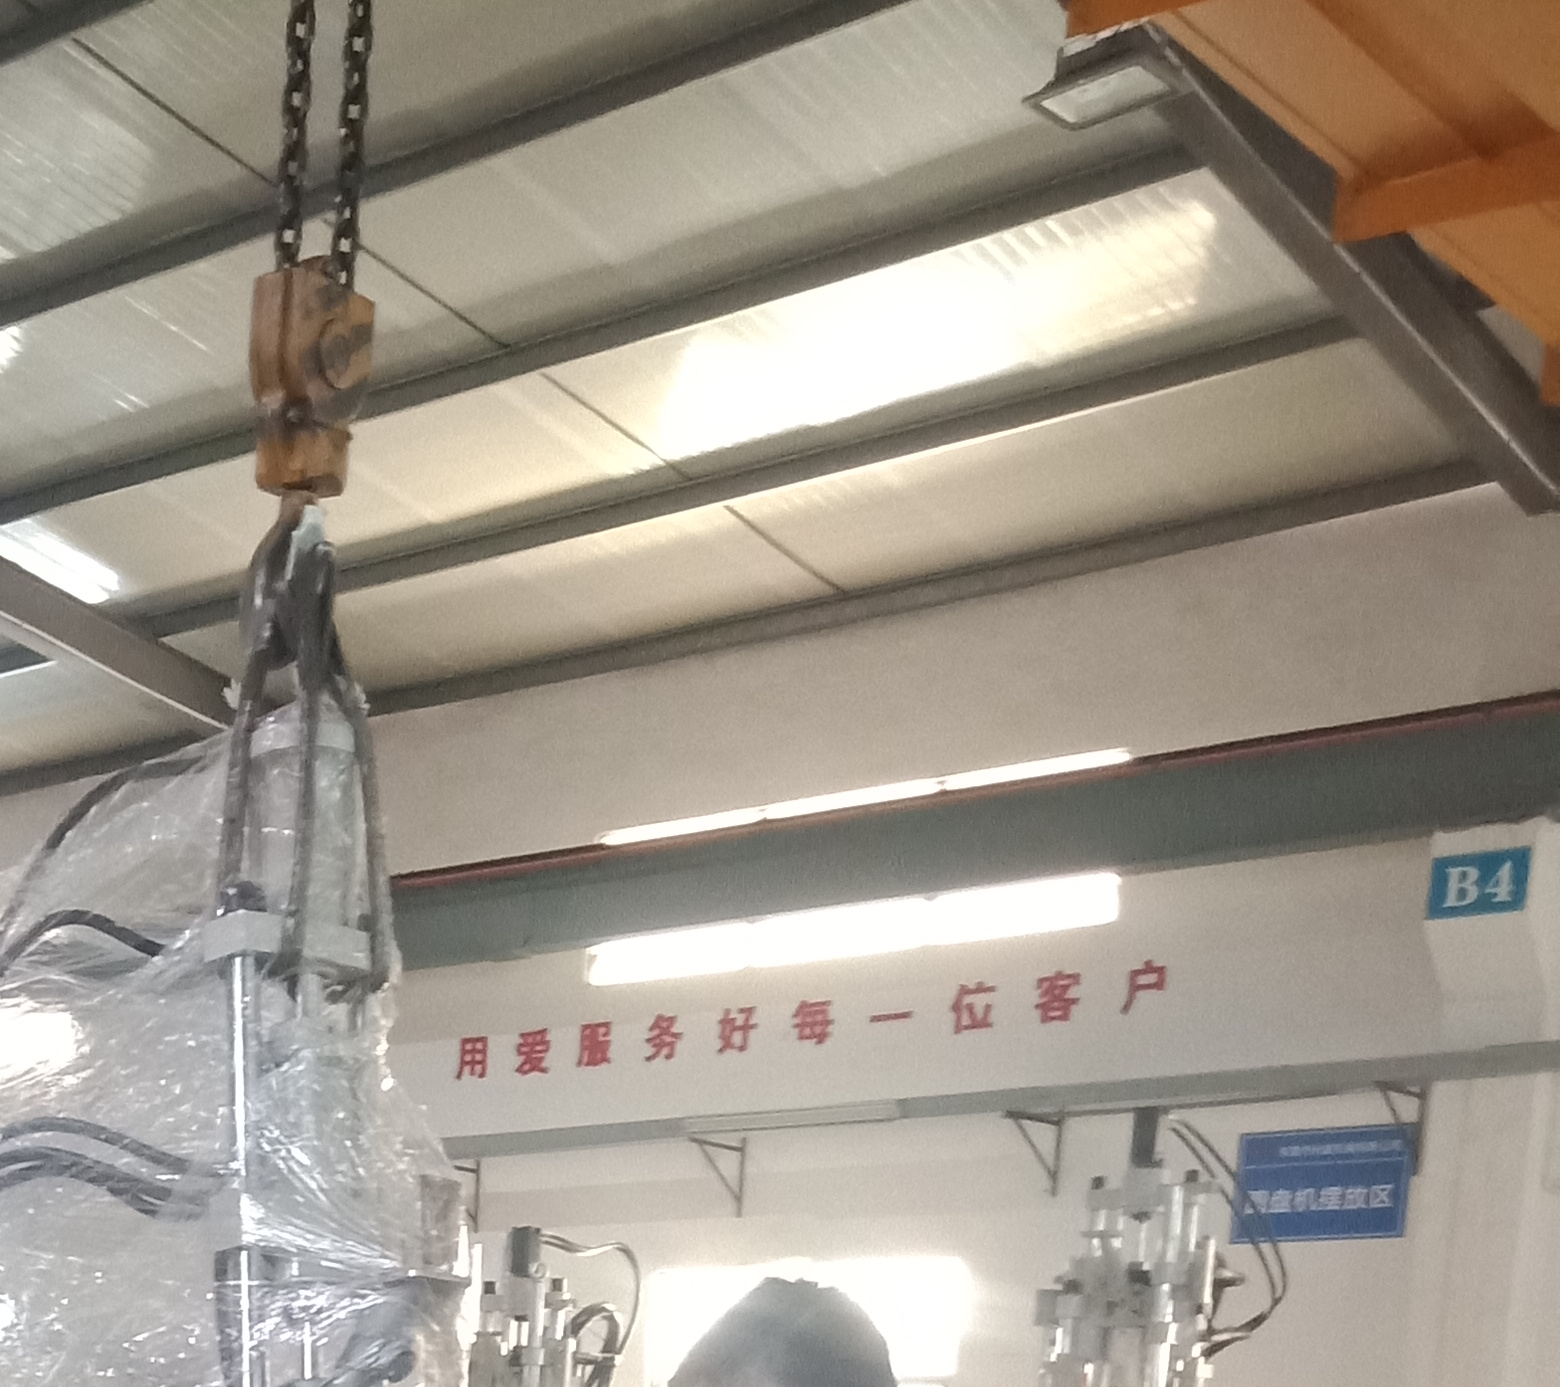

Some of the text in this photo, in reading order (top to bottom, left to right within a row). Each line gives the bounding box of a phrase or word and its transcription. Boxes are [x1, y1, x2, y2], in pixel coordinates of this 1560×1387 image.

[1442, 858, 1514, 908] B4
[454, 959, 1168, 1081] 用爱服务好每一位客户
